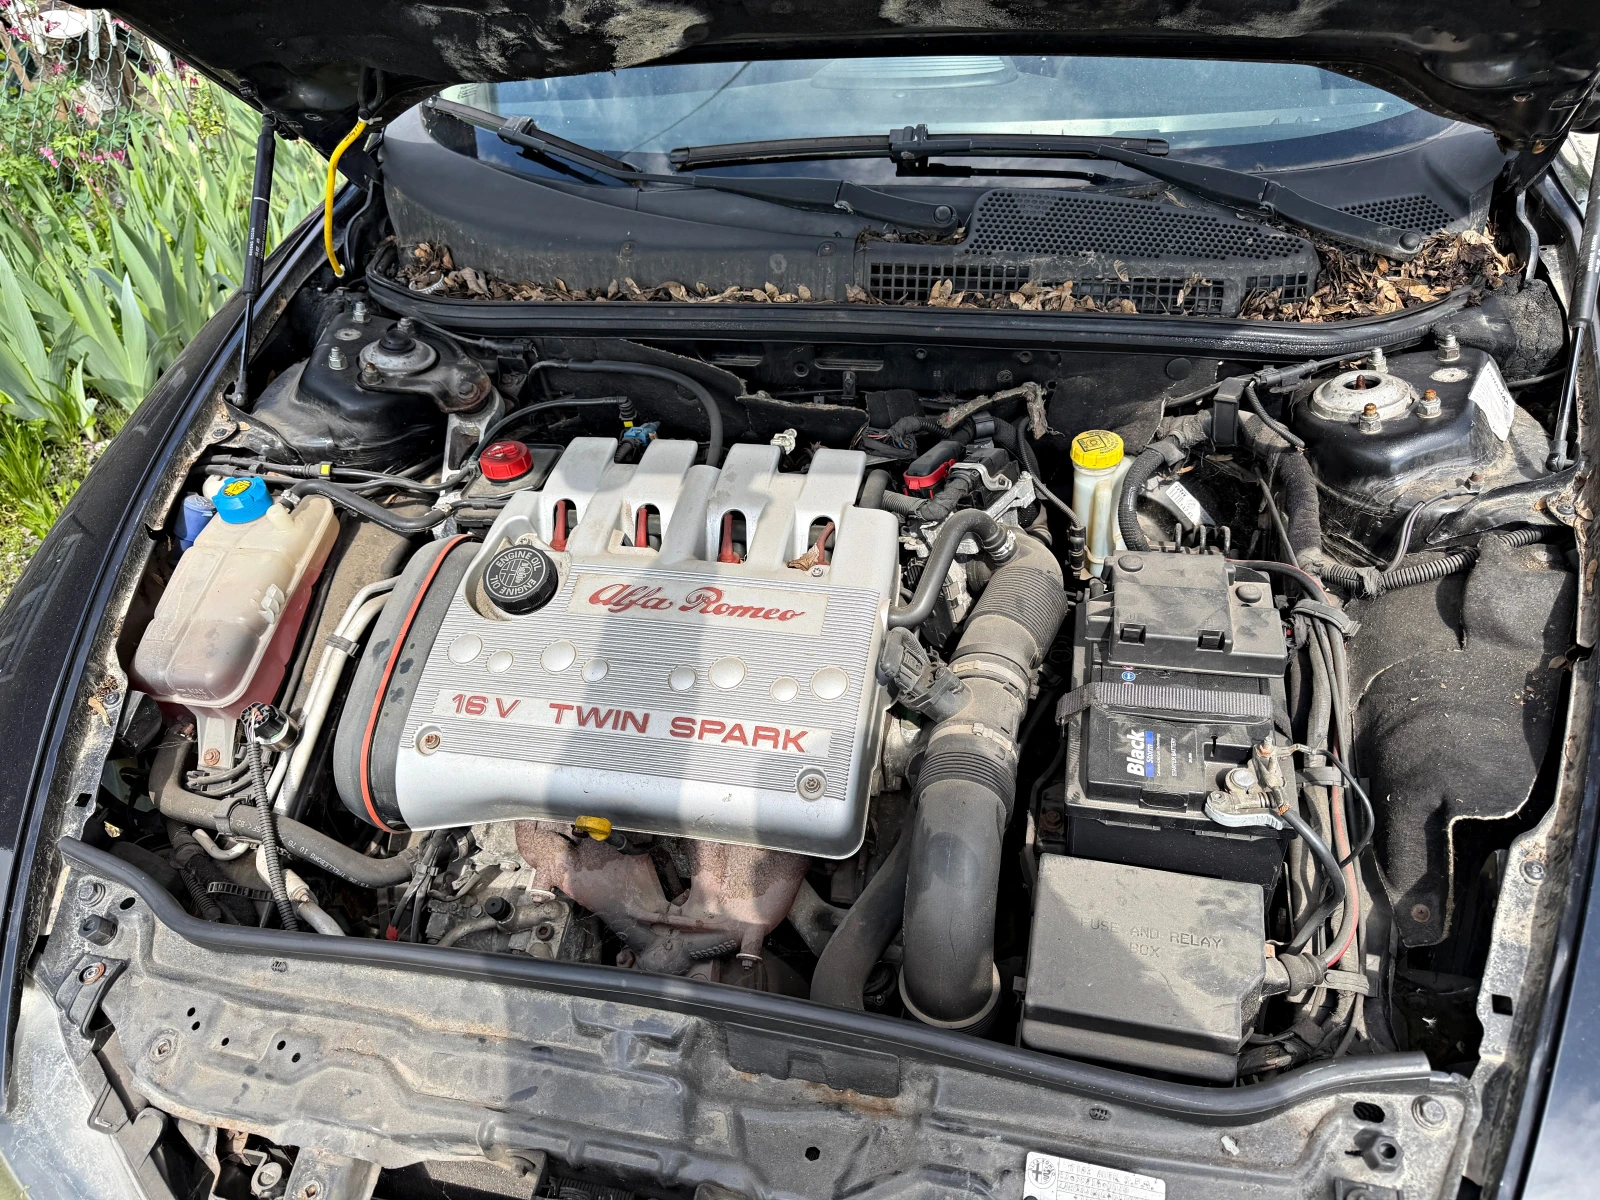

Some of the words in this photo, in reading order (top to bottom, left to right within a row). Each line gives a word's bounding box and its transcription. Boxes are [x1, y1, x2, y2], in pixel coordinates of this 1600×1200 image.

[496, 551, 532, 568] ENGINE
[531, 556, 542, 571] OIL
[490, 574, 500, 589] OIL
[499, 578, 537, 595] ENGINE
[588, 583, 675, 613] Alfa
[678, 586, 806, 621] Romeo
[452, 693, 488, 715] 16
[496, 697, 520, 718] V
[549, 702, 650, 734] TWIN
[669, 716, 808, 753] SPARK
[1126, 729, 1145, 777] Black
[300, 846, 308, 855] 10
[1080, 917, 1119, 933] FUSE
[1131, 926, 1159, 940] AND
[1170, 932, 1221, 949] RELAY
[1130, 942, 1160, 958] BOX
